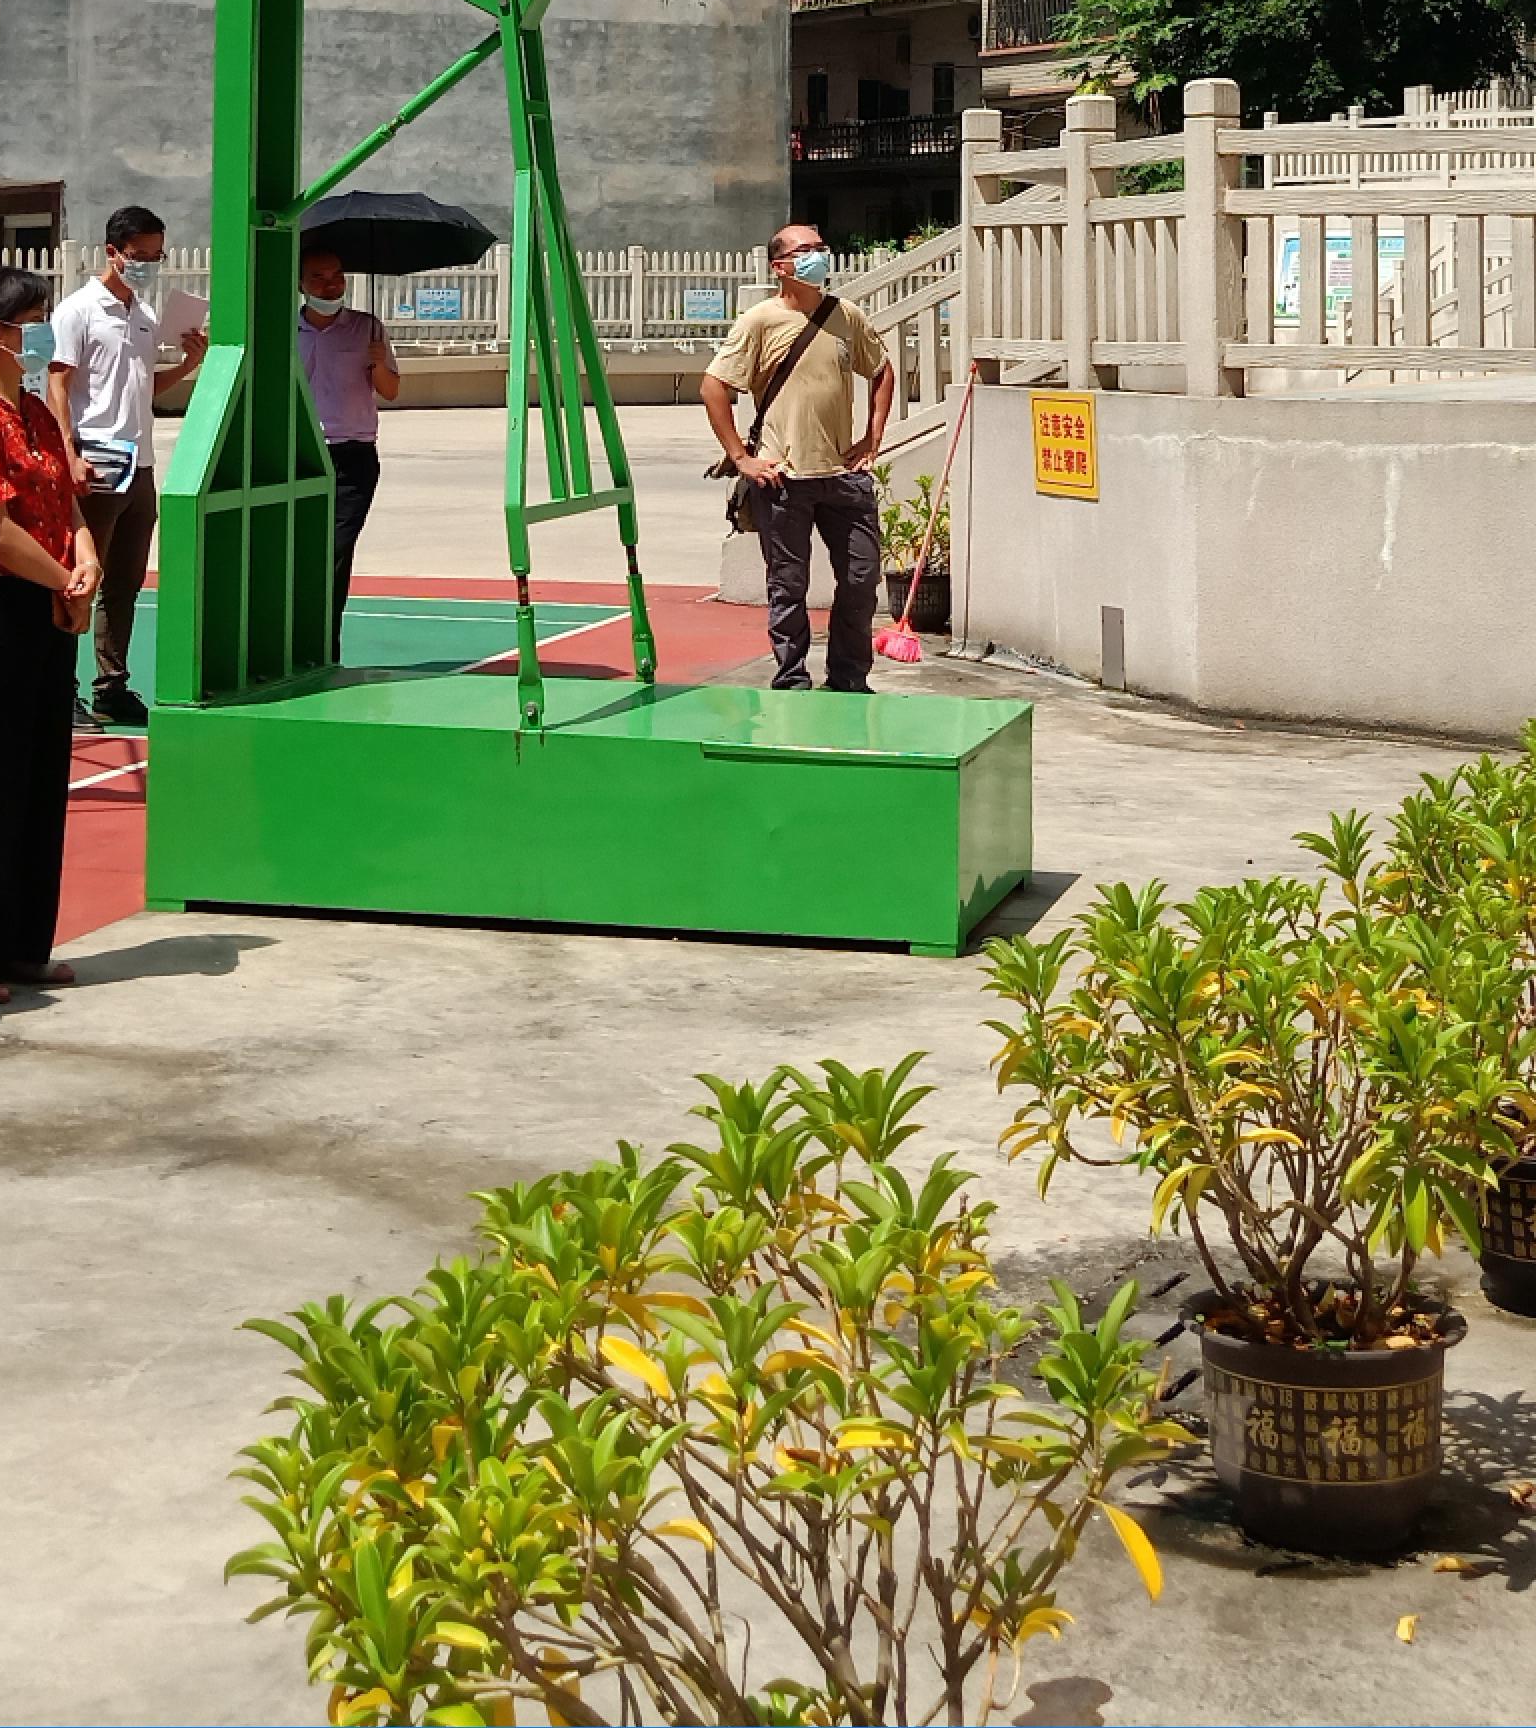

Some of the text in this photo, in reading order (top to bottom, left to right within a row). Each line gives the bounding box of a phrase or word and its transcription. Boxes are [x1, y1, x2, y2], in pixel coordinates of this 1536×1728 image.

[1039, 412, 1085, 441] 注意安全
[1041, 447, 1087, 476] 禁止攀爬
